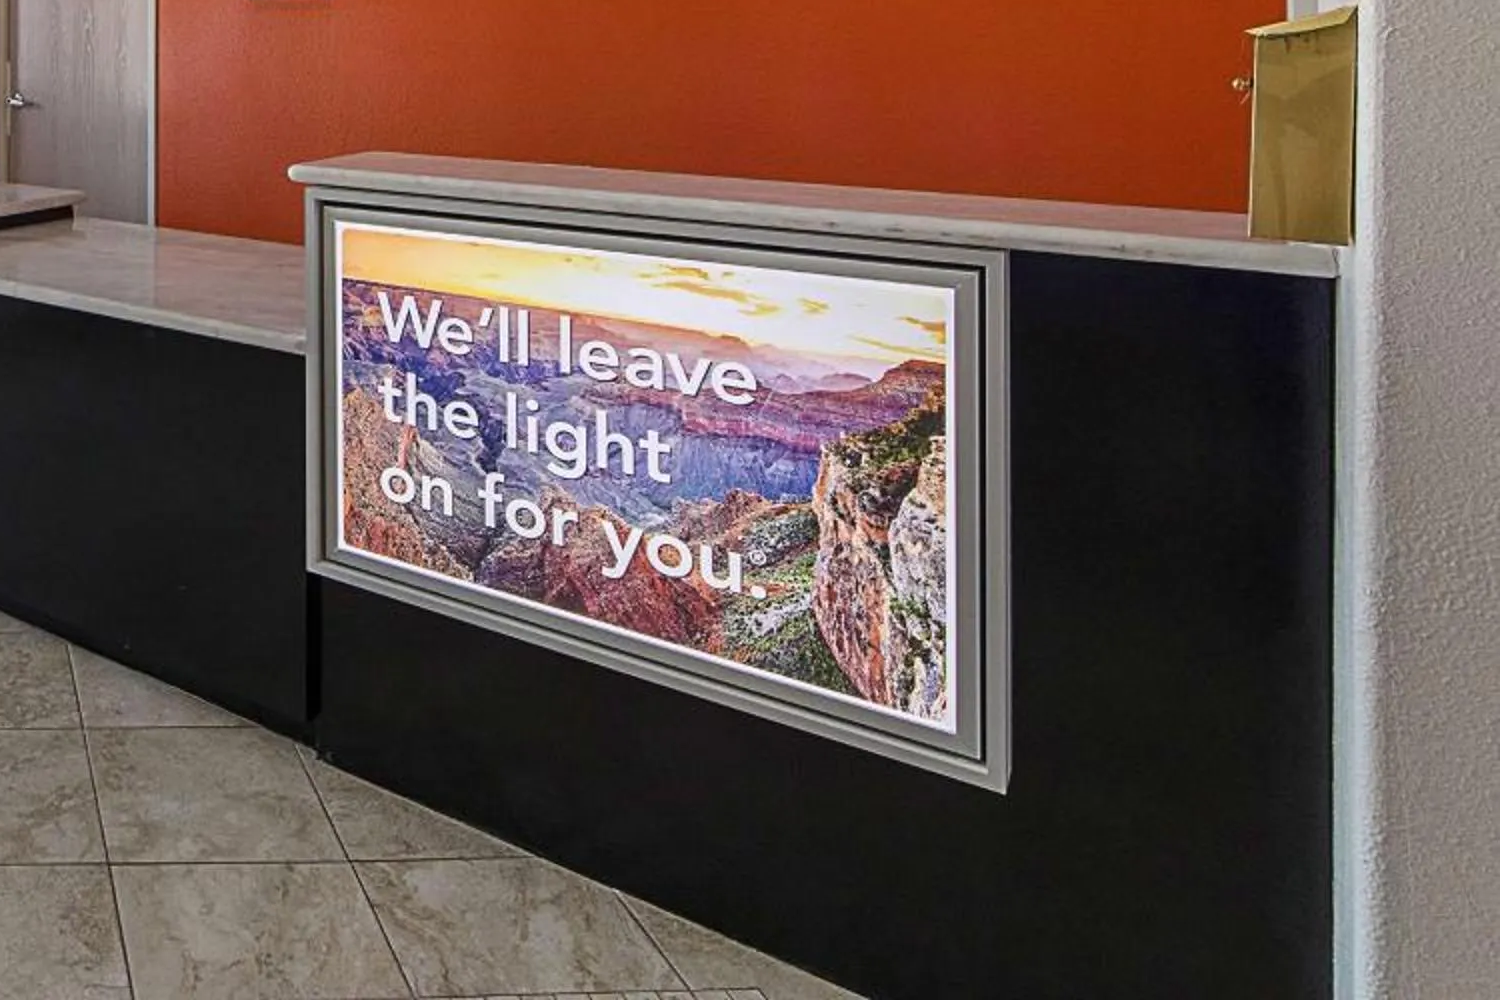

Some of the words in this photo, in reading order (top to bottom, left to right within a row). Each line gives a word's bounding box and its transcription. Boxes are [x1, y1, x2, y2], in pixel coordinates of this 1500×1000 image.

[377, 291, 530, 367] We'll
[559, 314, 758, 406] leave
[377, 371, 479, 440] the
[506, 391, 673, 484] light
[380, 466, 454, 517] on
[477, 471, 580, 546] for
